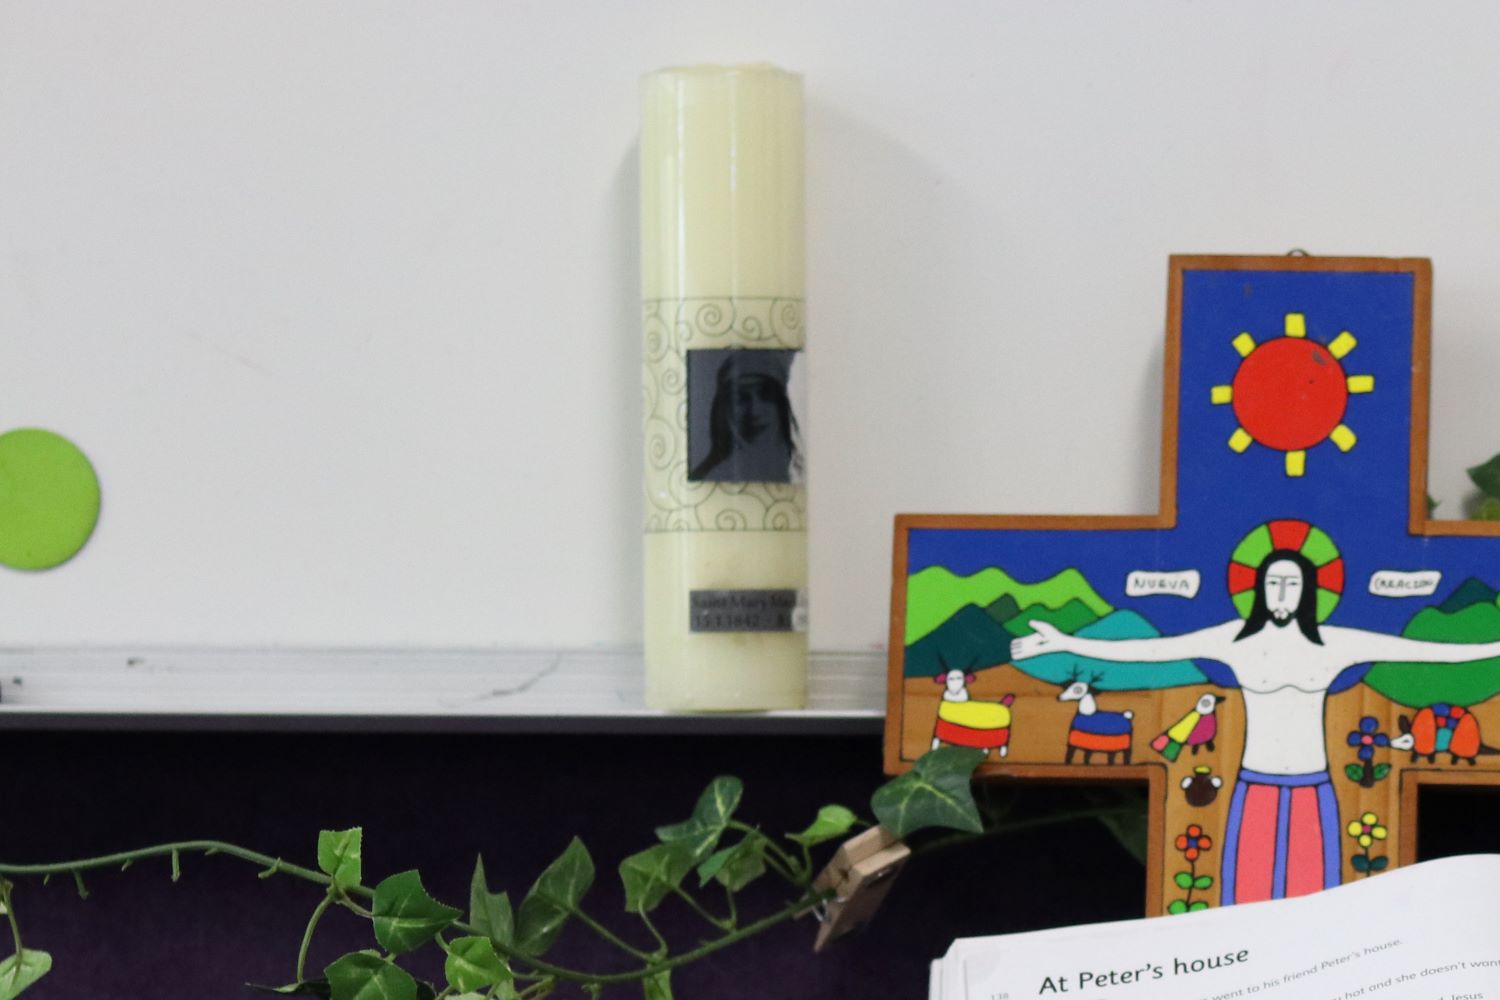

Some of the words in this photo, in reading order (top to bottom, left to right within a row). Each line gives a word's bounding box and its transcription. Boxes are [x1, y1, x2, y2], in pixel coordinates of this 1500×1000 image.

[1133, 576, 1190, 590] NUEVA
[1038, 976, 1068, 994] At
[1079, 963, 1163, 989] Peter's
[1173, 949, 1248, 975] house
[990, 991, 1009, 1000] 138
